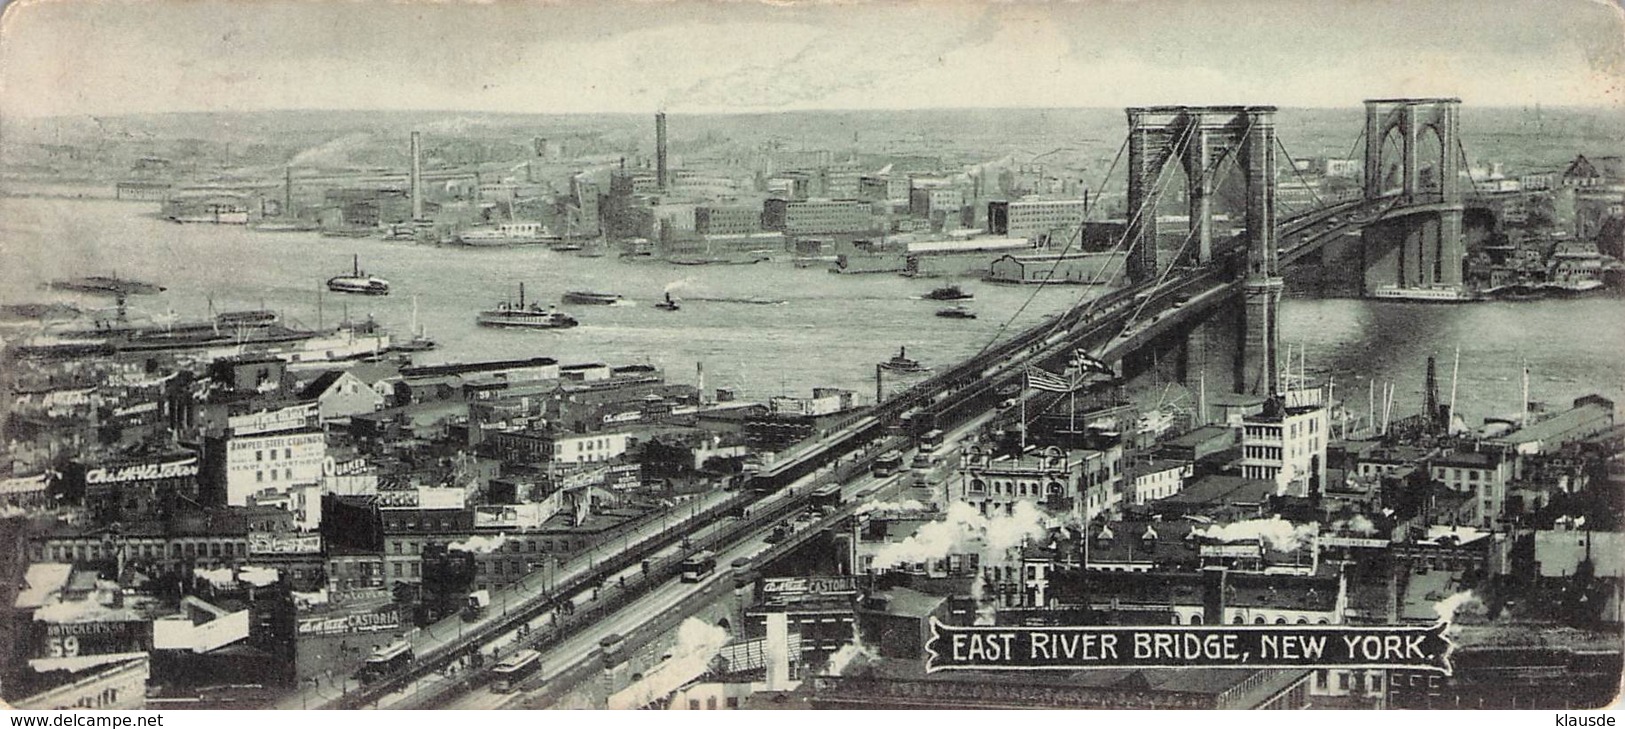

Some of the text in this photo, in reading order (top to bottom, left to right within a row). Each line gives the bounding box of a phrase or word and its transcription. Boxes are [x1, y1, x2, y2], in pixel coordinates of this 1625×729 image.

[323, 455, 366, 477] QUAKER
[809, 578, 857, 593] CASTORIA
[348, 610, 399, 627] CASTORIA
[50, 635, 80, 658] 59
